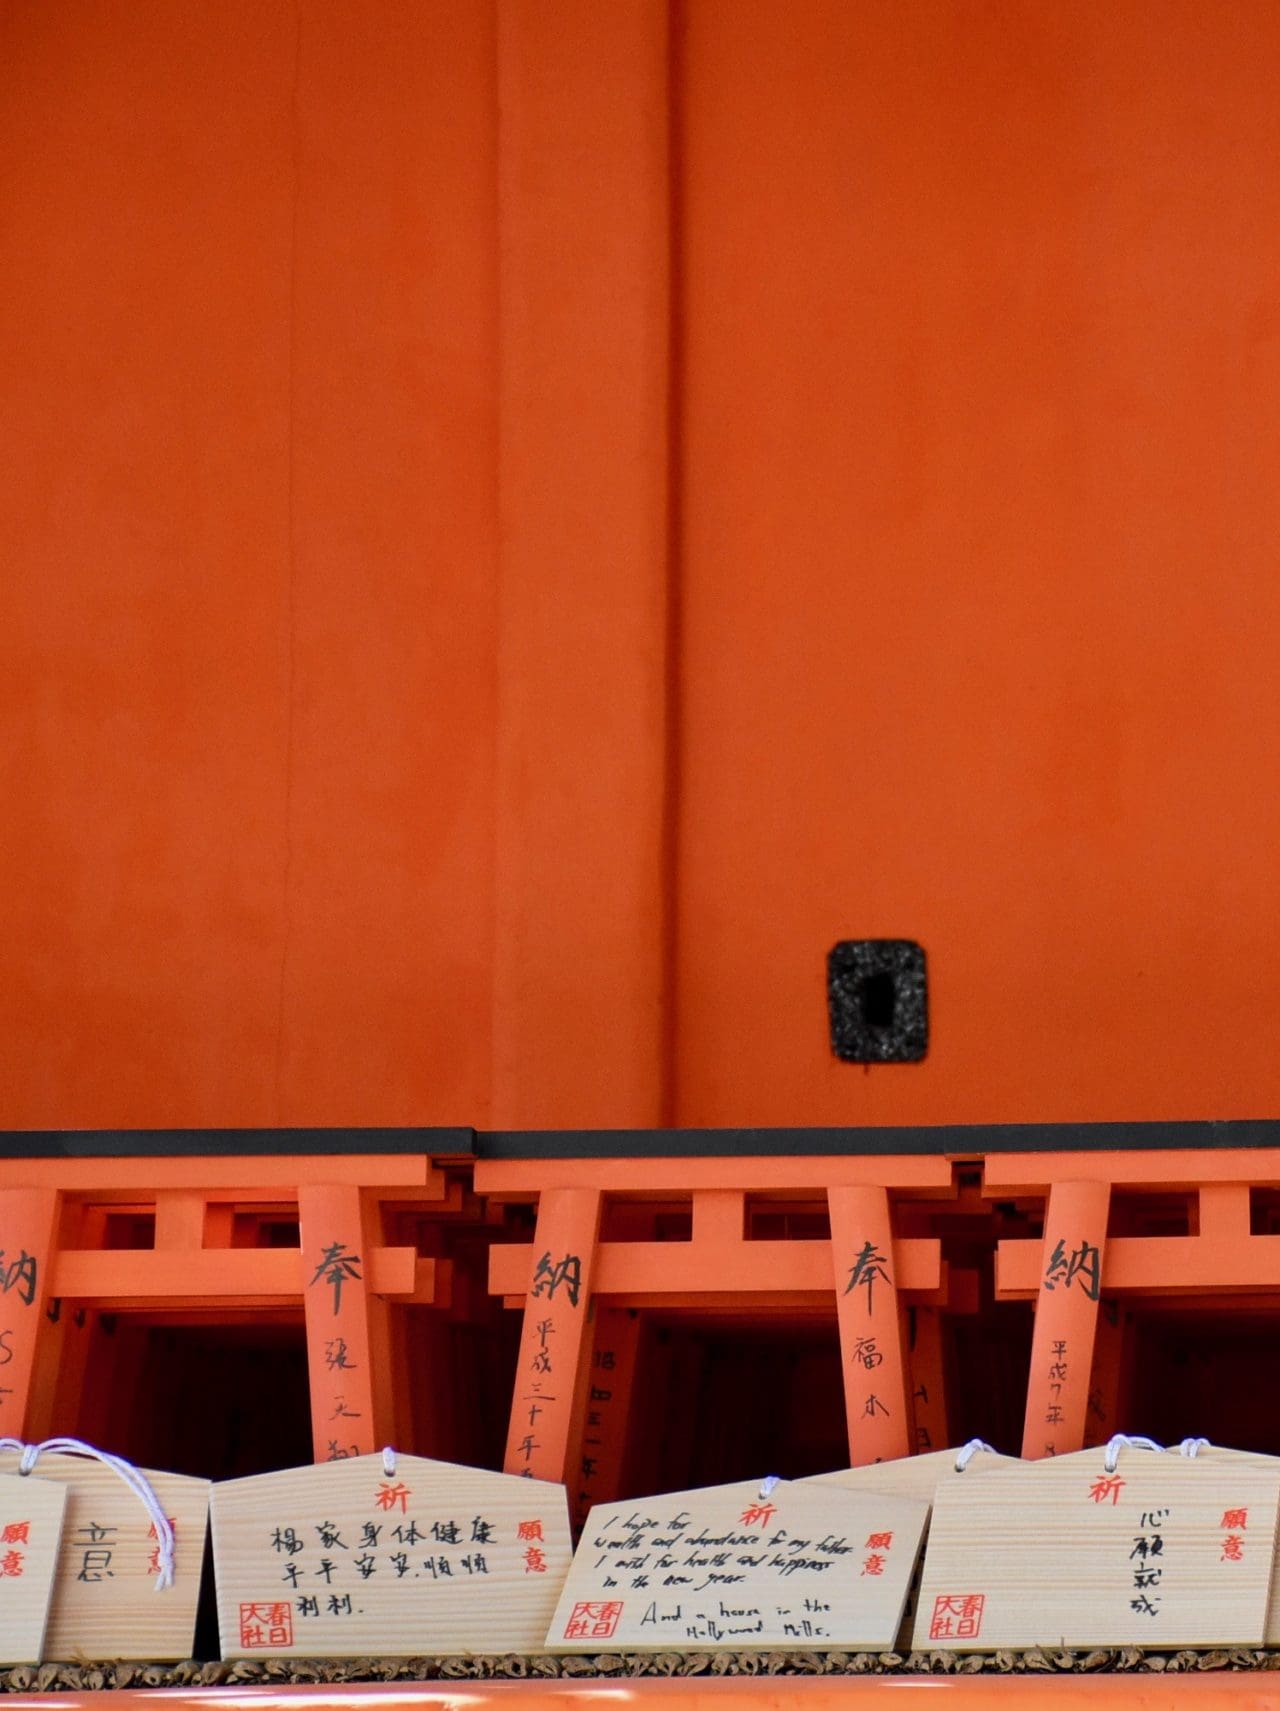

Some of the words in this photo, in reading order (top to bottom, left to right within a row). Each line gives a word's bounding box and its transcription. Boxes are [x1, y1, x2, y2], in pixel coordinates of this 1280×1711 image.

[309, 1242, 362, 1316] 奉
[531, 1251, 582, 1307] 納
[843, 1241, 892, 1316] 奉
[1043, 1239, 1100, 1301] 納
[375, 1482, 413, 1514] 祈
[1088, 1474, 1127, 1506] 祈
[622, 1511, 660, 1536] hope
[667, 1511, 692, 1531] for
[738, 1502, 778, 1529] 祈
[517, 1519, 548, 1573] 願意
[651, 1532, 683, 1548] and
[788, 1540, 811, 1556] my
[1220, 1507, 1249, 1562] 願意
[654, 1554, 678, 1570] for
[683, 1550, 733, 1567] health
[736, 1554, 765, 1567] and
[860, 1531, 894, 1576] 願意
[630, 1575, 649, 1590] the
[640, 1601, 681, 1625] And
[719, 1601, 761, 1617] house
[803, 1598, 831, 1612] the
